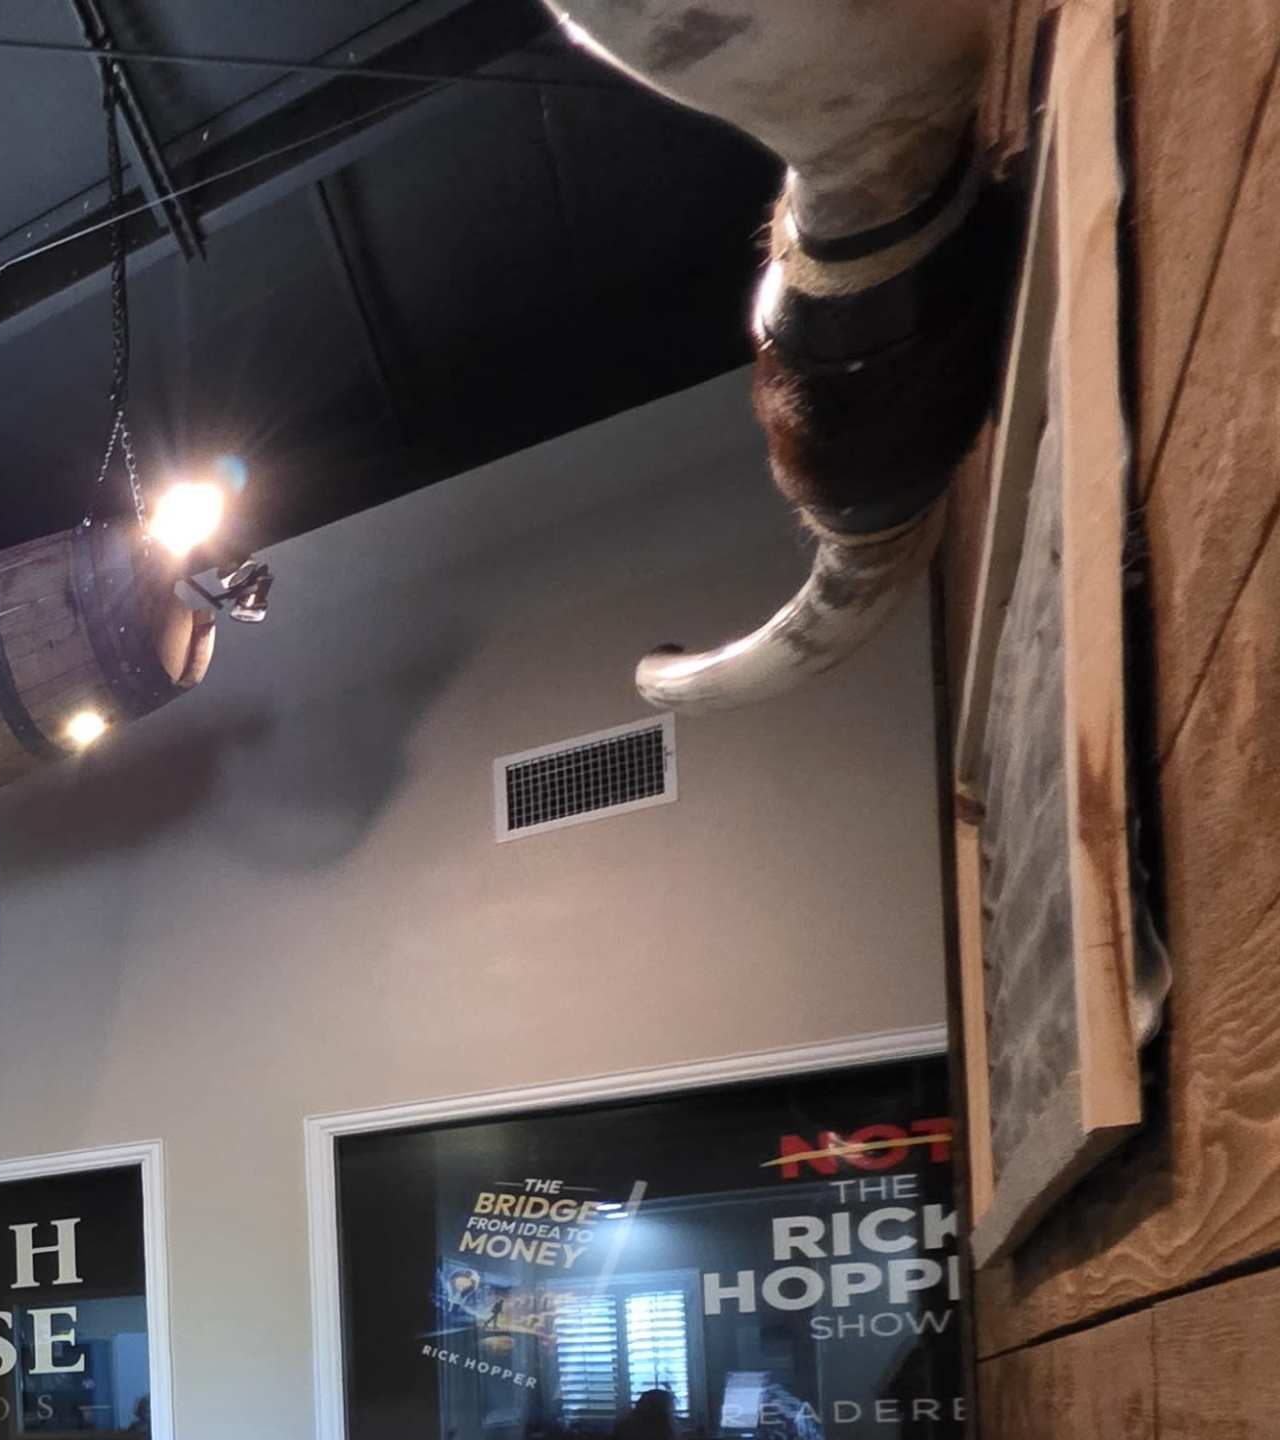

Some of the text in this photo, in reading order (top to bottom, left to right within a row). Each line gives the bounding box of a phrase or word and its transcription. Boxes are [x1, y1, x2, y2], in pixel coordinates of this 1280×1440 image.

[779, 1117, 954, 1180] NOT
[524, 1178, 563, 1194] THE
[829, 1173, 920, 1204] THE
[473, 1191, 601, 1226] BRIDGE
[466, 1217, 594, 1243] FROM IDEA TO
[772, 1203, 958, 1261] RICK
[459, 1232, 587, 1269] MONEY
[810, 1308, 953, 1340] SHOW
[421, 1344, 538, 1389] RICK HOPPER
